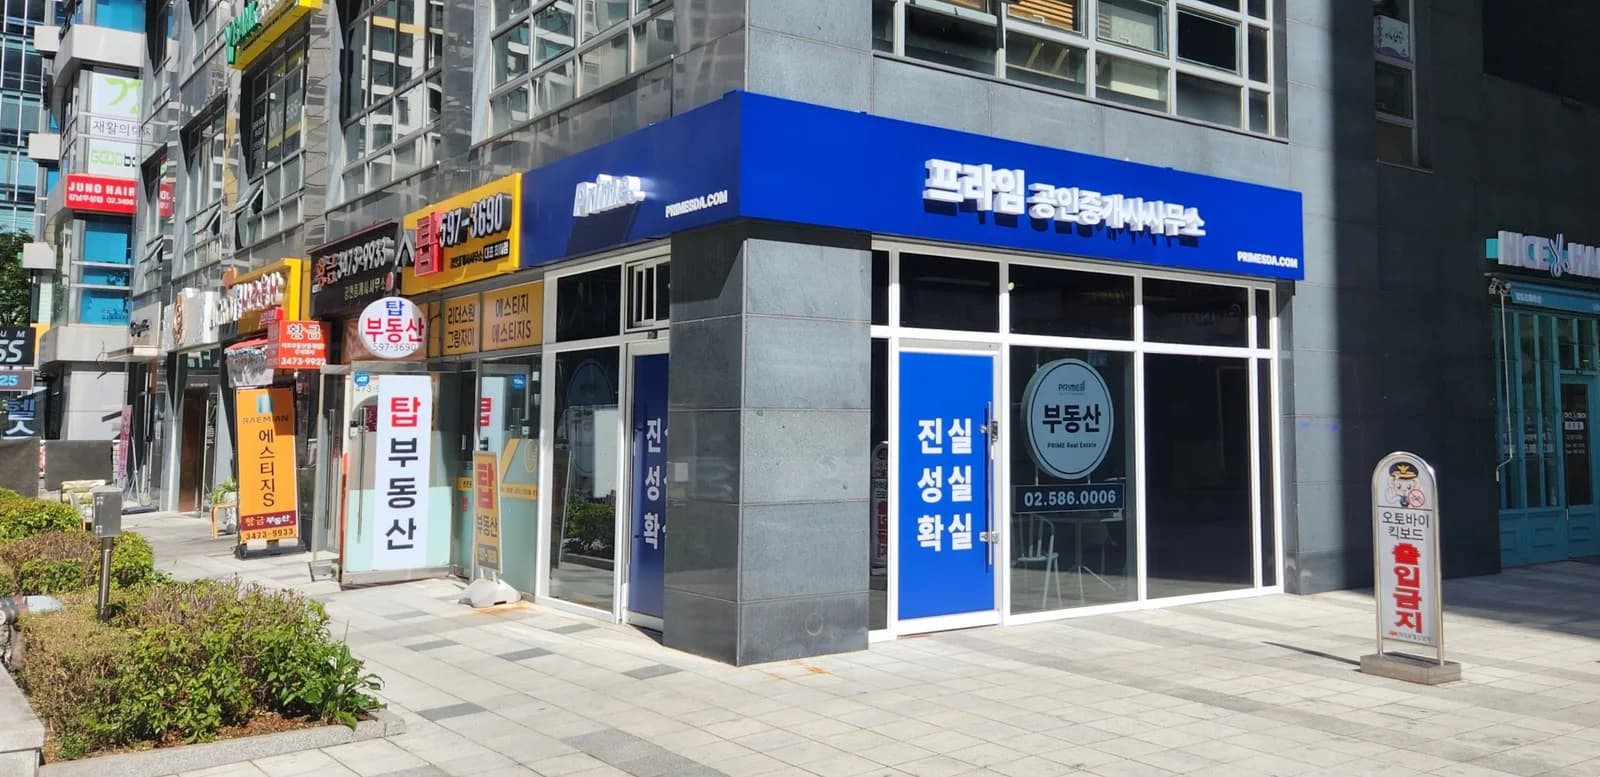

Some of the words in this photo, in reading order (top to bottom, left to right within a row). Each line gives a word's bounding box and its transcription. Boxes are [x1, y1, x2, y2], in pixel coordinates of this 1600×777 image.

[68, 181, 102, 194] JUNO
[922, 158, 1026, 216] 프라임
[1026, 182, 1207, 237] 공인중개사사무소
[665, 189, 728, 219] PRIMESDA.COM
[415, 210, 442, 277] 탑
[439, 193, 512, 248] 597-3690
[1236, 250, 1299, 269] PRIMESDA.COM
[385, 300, 405, 316] 탑
[447, 303, 475, 325] 리더스원
[495, 294, 529, 319] 에스티지
[287, 323, 321, 339] 황금
[365, 317, 425, 343] 부동산
[447, 328, 475, 349] 그랑자이
[491, 320, 532, 344] 에스티지S
[372, 343, 417, 351] 597-3690
[243, 416, 289, 424] RAEMIAN
[391, 396, 421, 427] 탑
[1042, 403, 1102, 434] 부동산
[917, 417, 972, 455] 진실
[1066, 441, 1079, 449] Real
[1079, 441, 1097, 449] Estate
[258, 428, 276, 508] 에스티지S
[385, 437, 419, 551] 부동산
[477, 463, 494, 509] 탑
[917, 465, 972, 503] 성실
[1023, 489, 1117, 507] 02.586.0006
[477, 514, 498, 537] 부동산
[917, 512, 972, 551] 확실
[1381, 511, 1430, 529] 오토바이
[1387, 526, 1425, 541] 킥보드
[1391, 542, 1424, 634] 출입금지
